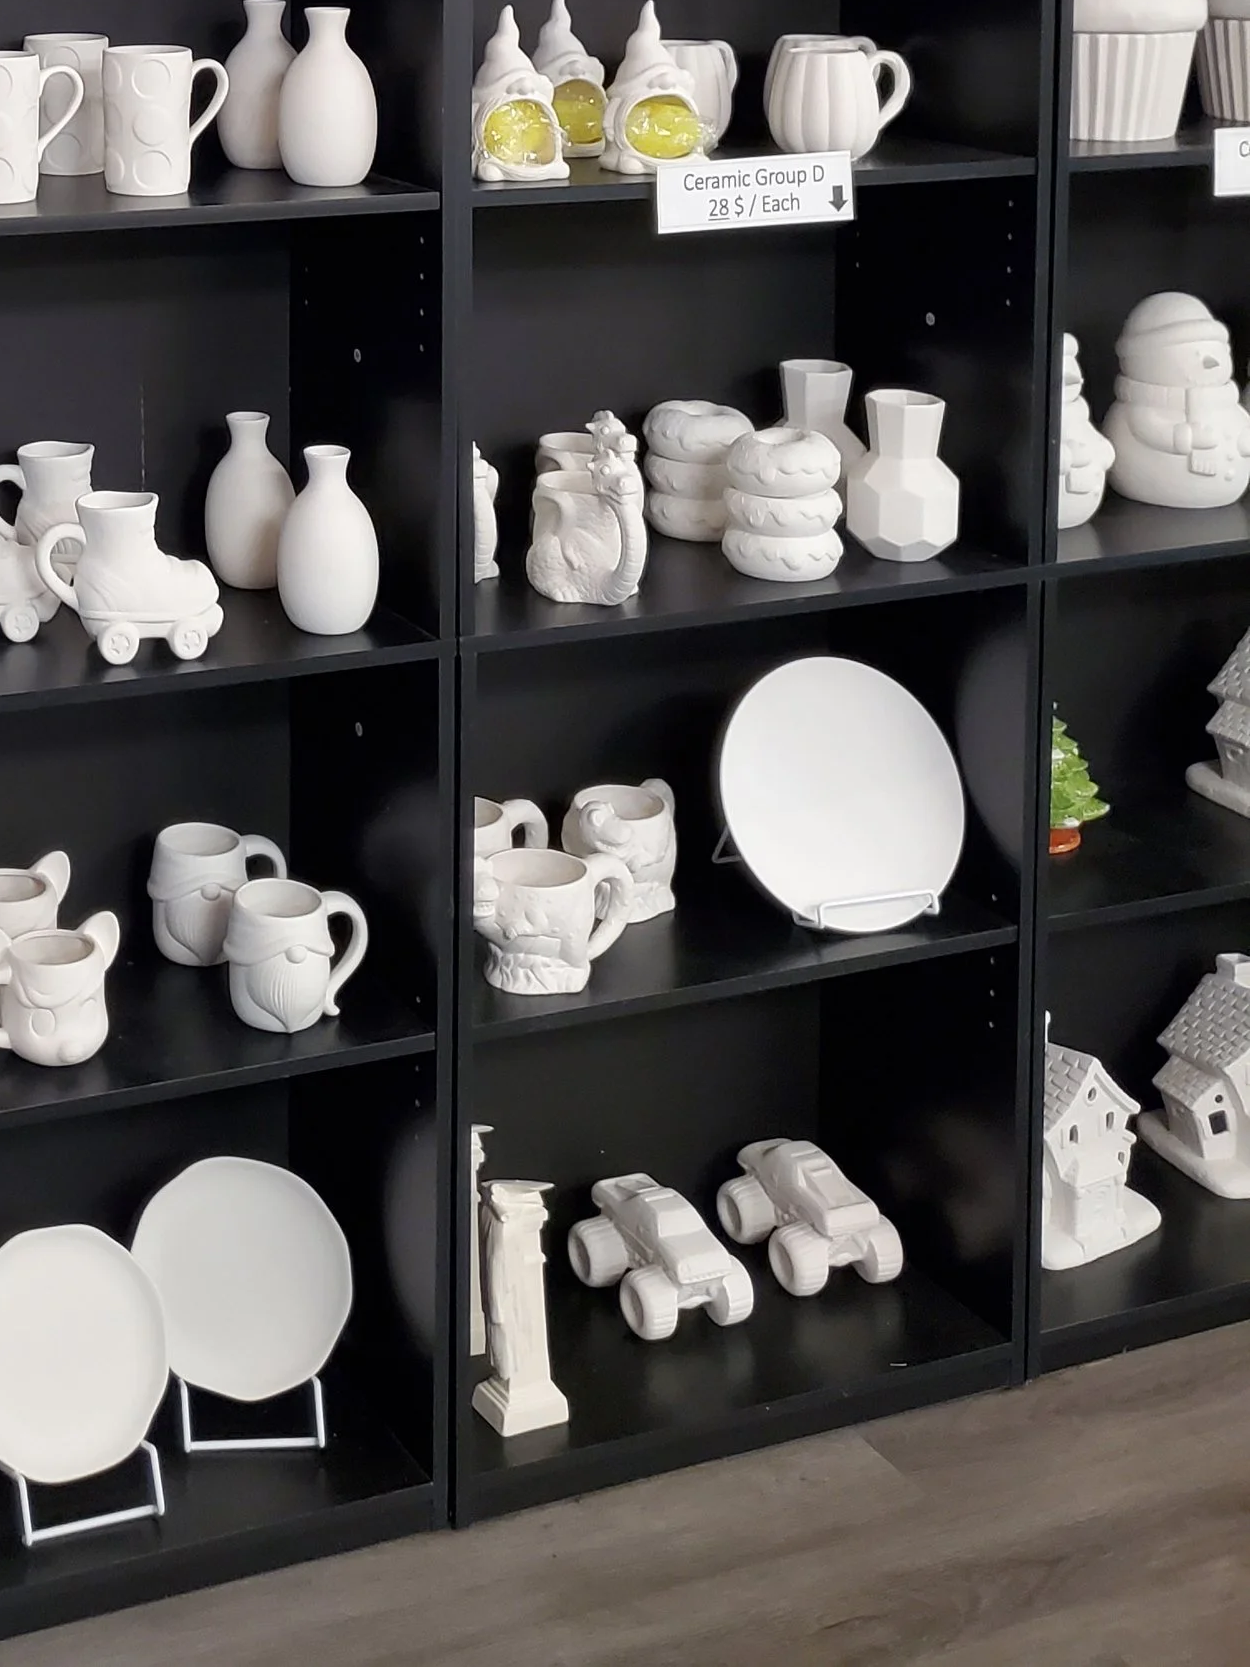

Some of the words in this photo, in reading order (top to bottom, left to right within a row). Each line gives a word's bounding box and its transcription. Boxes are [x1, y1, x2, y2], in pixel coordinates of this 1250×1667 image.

[683, 169, 751, 191] Ceramic
[755, 168, 807, 188] Group
[812, 165, 825, 183] D
[708, 198, 730, 221] 28
[734, 194, 745, 218] $
[748, 194, 757, 217] /
[762, 192, 800, 213] Each
